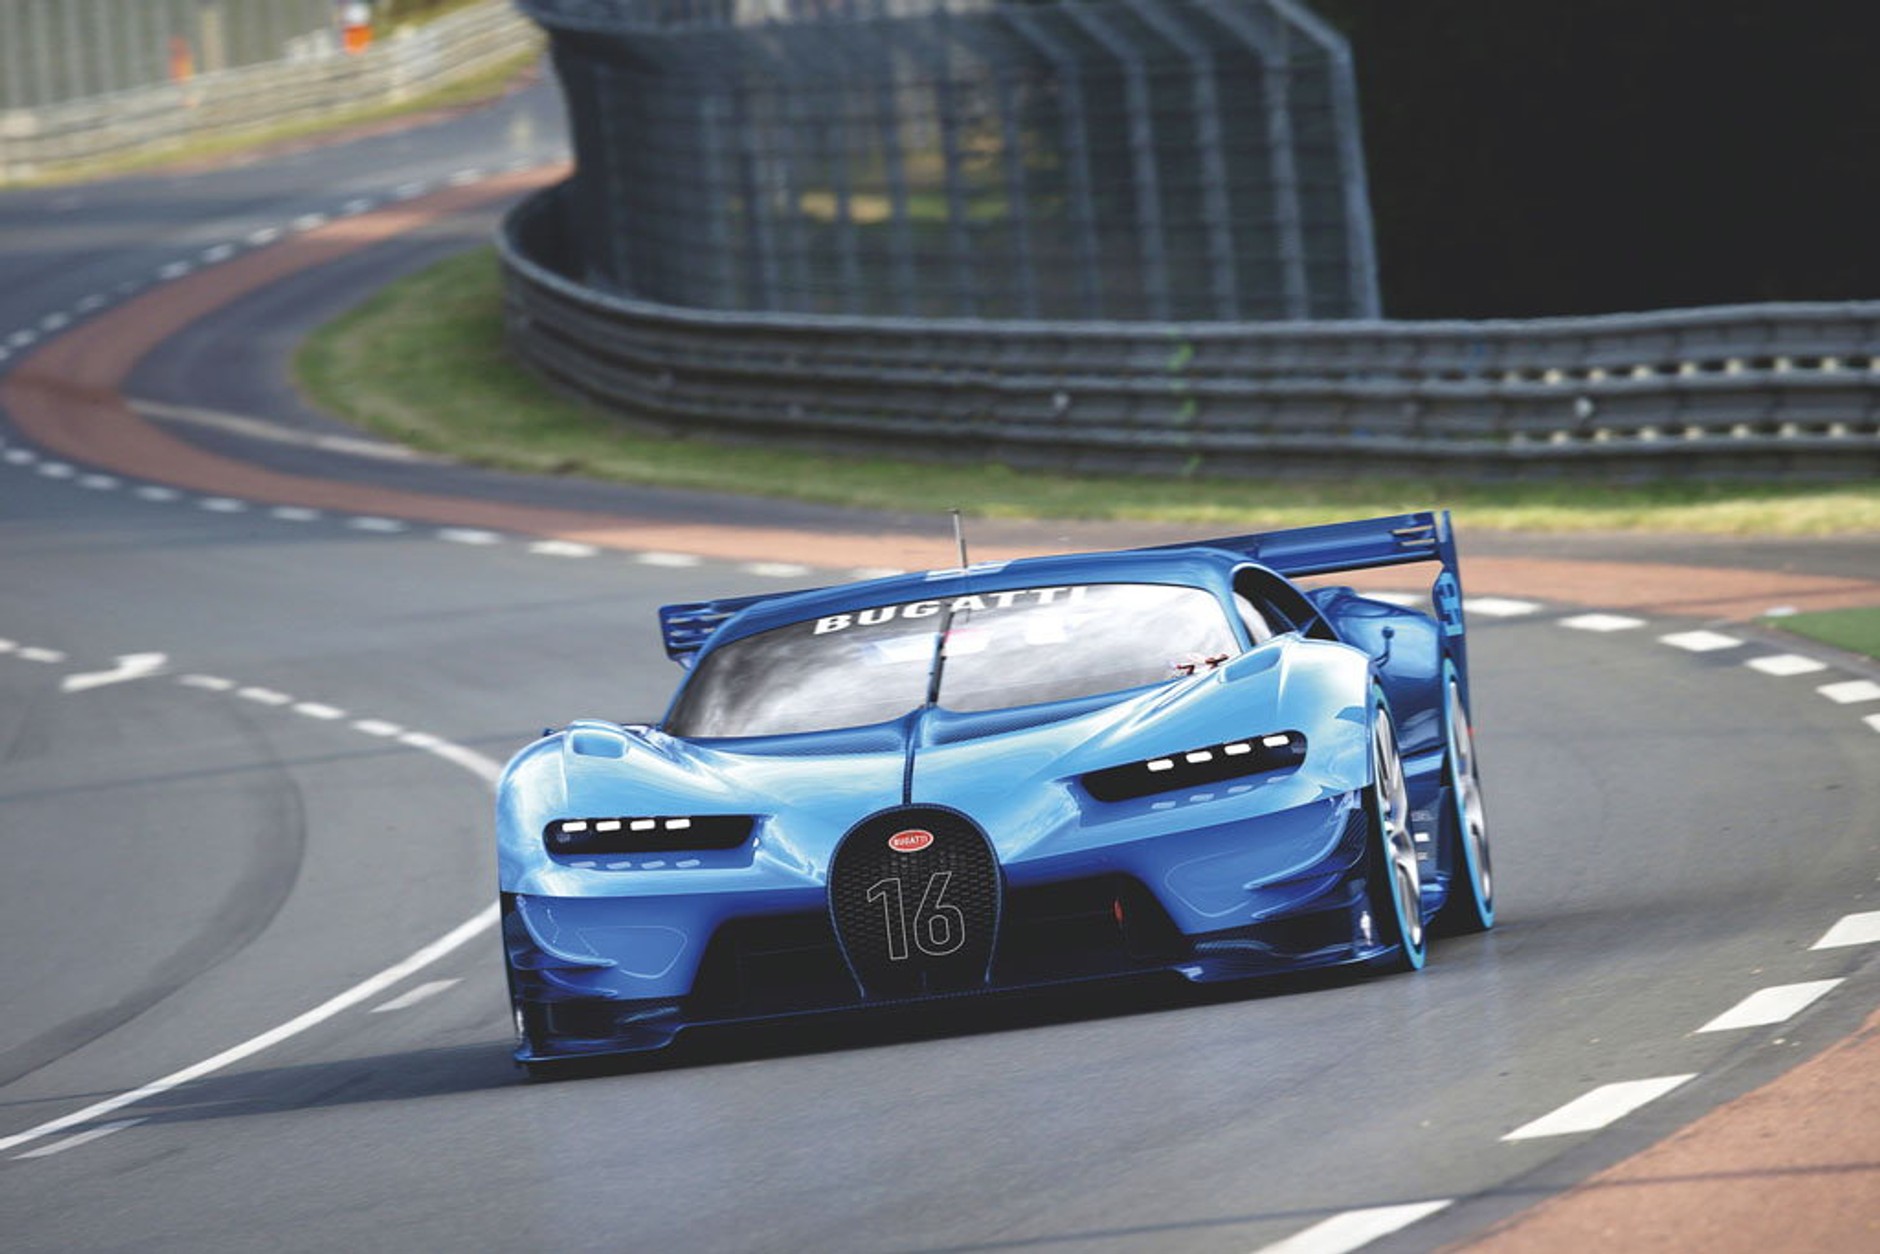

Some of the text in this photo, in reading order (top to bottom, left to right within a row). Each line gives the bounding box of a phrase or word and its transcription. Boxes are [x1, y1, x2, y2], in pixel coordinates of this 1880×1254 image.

[813, 586, 1088, 635] BUGATTI
[893, 834, 929, 846] BUGATTI
[866, 870, 966, 961] 16
